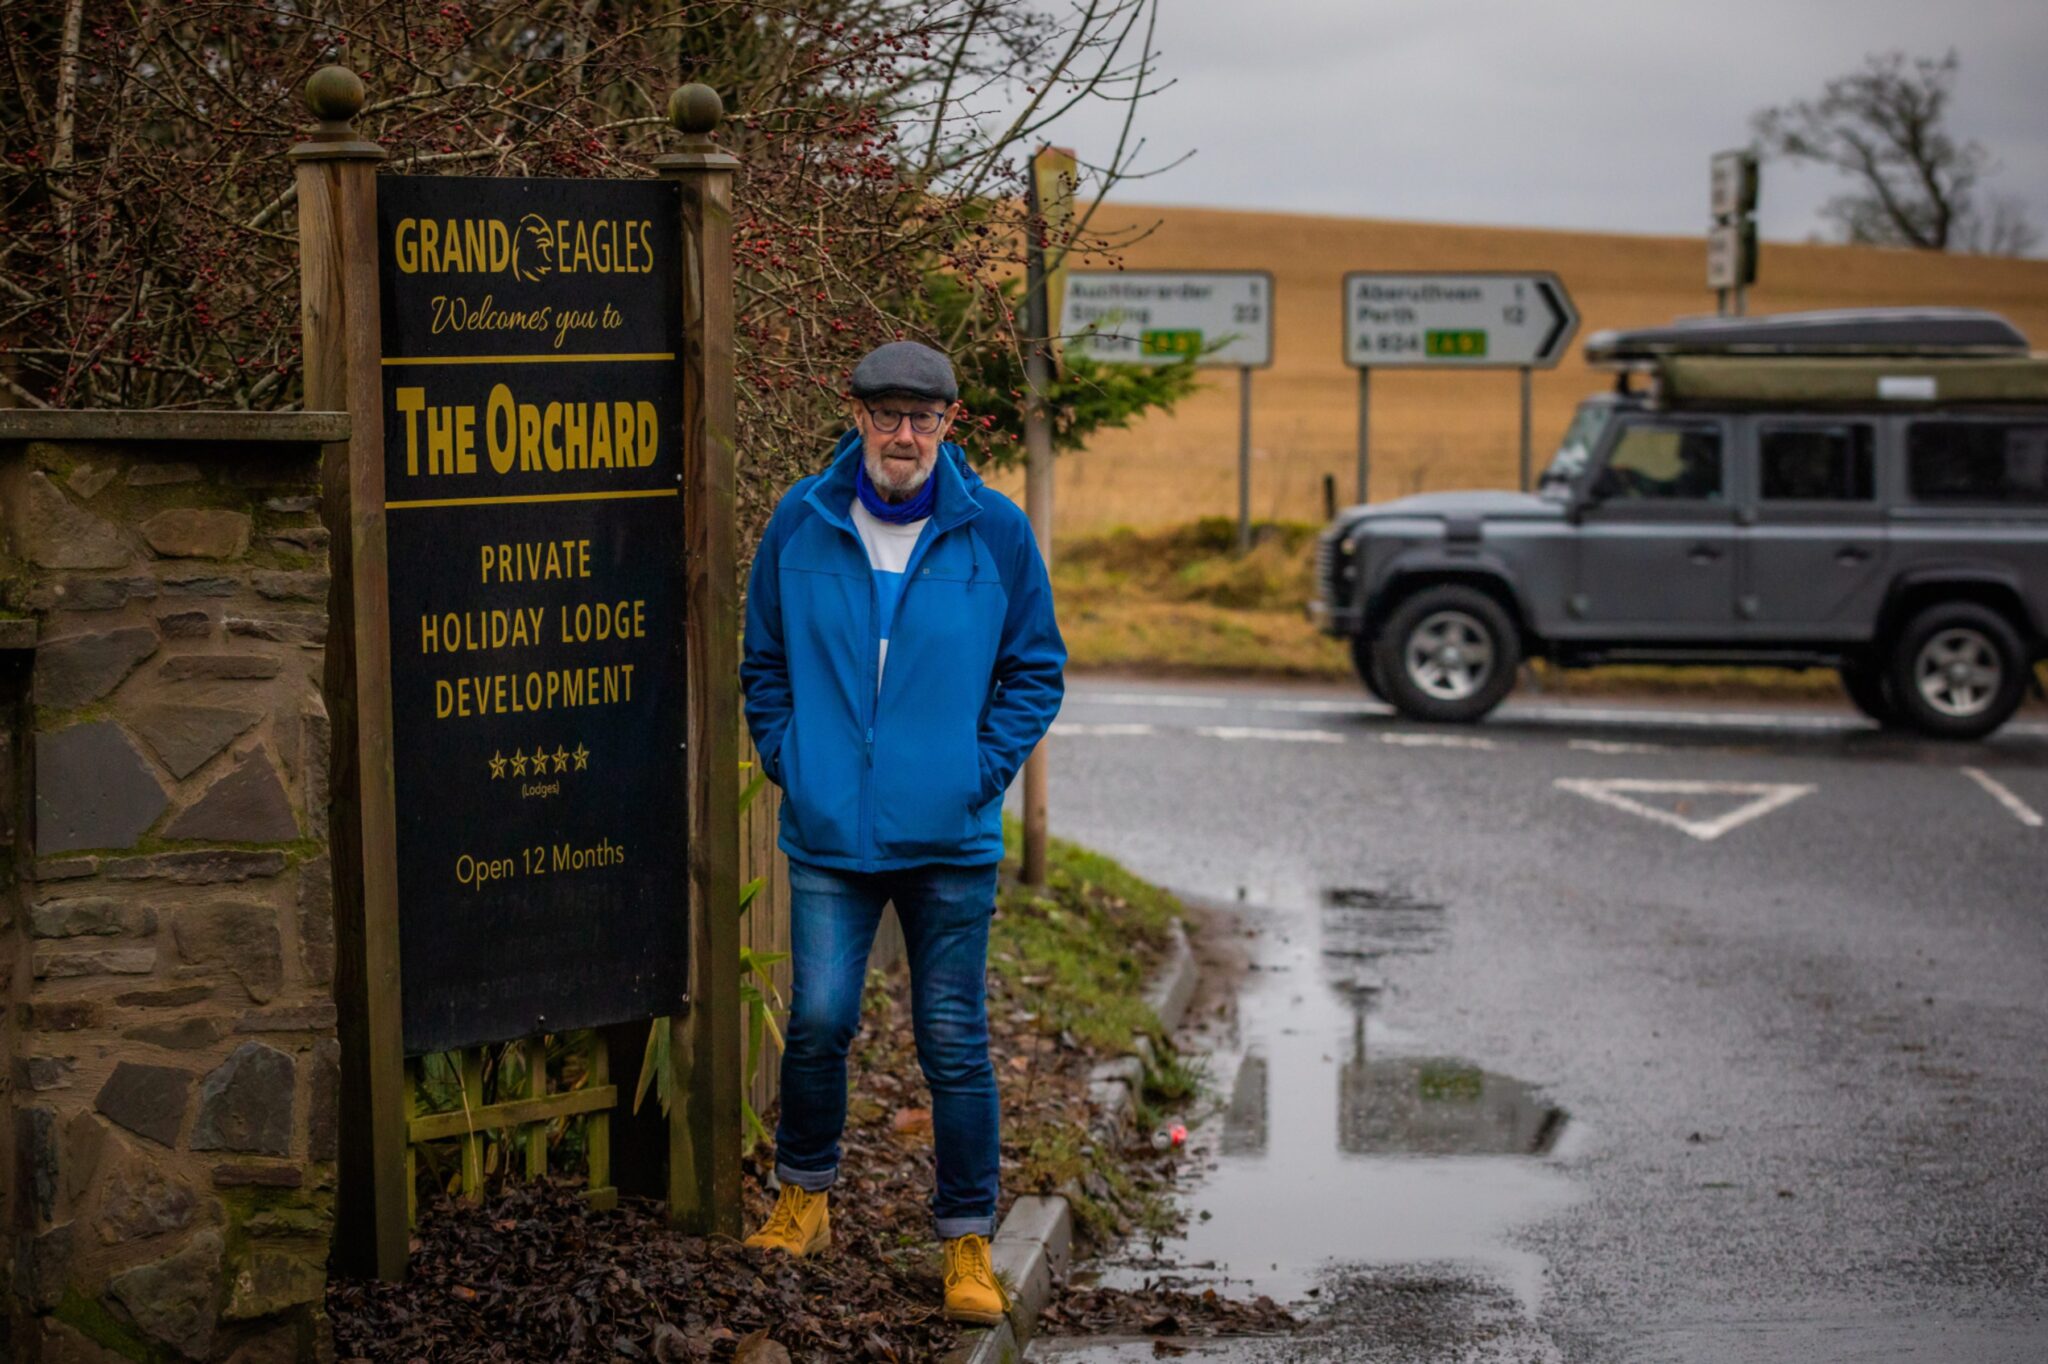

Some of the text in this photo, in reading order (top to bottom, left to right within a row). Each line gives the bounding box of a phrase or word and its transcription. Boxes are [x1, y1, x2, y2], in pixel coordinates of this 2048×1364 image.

[395, 217, 654, 274] GRAND EAGLES
[431, 294, 624, 349] Welcomes you to
[1358, 306, 1524, 323] Perth 12
[481, 540, 591, 584] PRIVATE
[421, 600, 646, 654] HOLIDAY LODGE
[435, 664, 635, 719] DEVELOPMENT
[521, 780, 560, 799] (Lodges)
[455, 837, 625, 892] Open 12 Months
